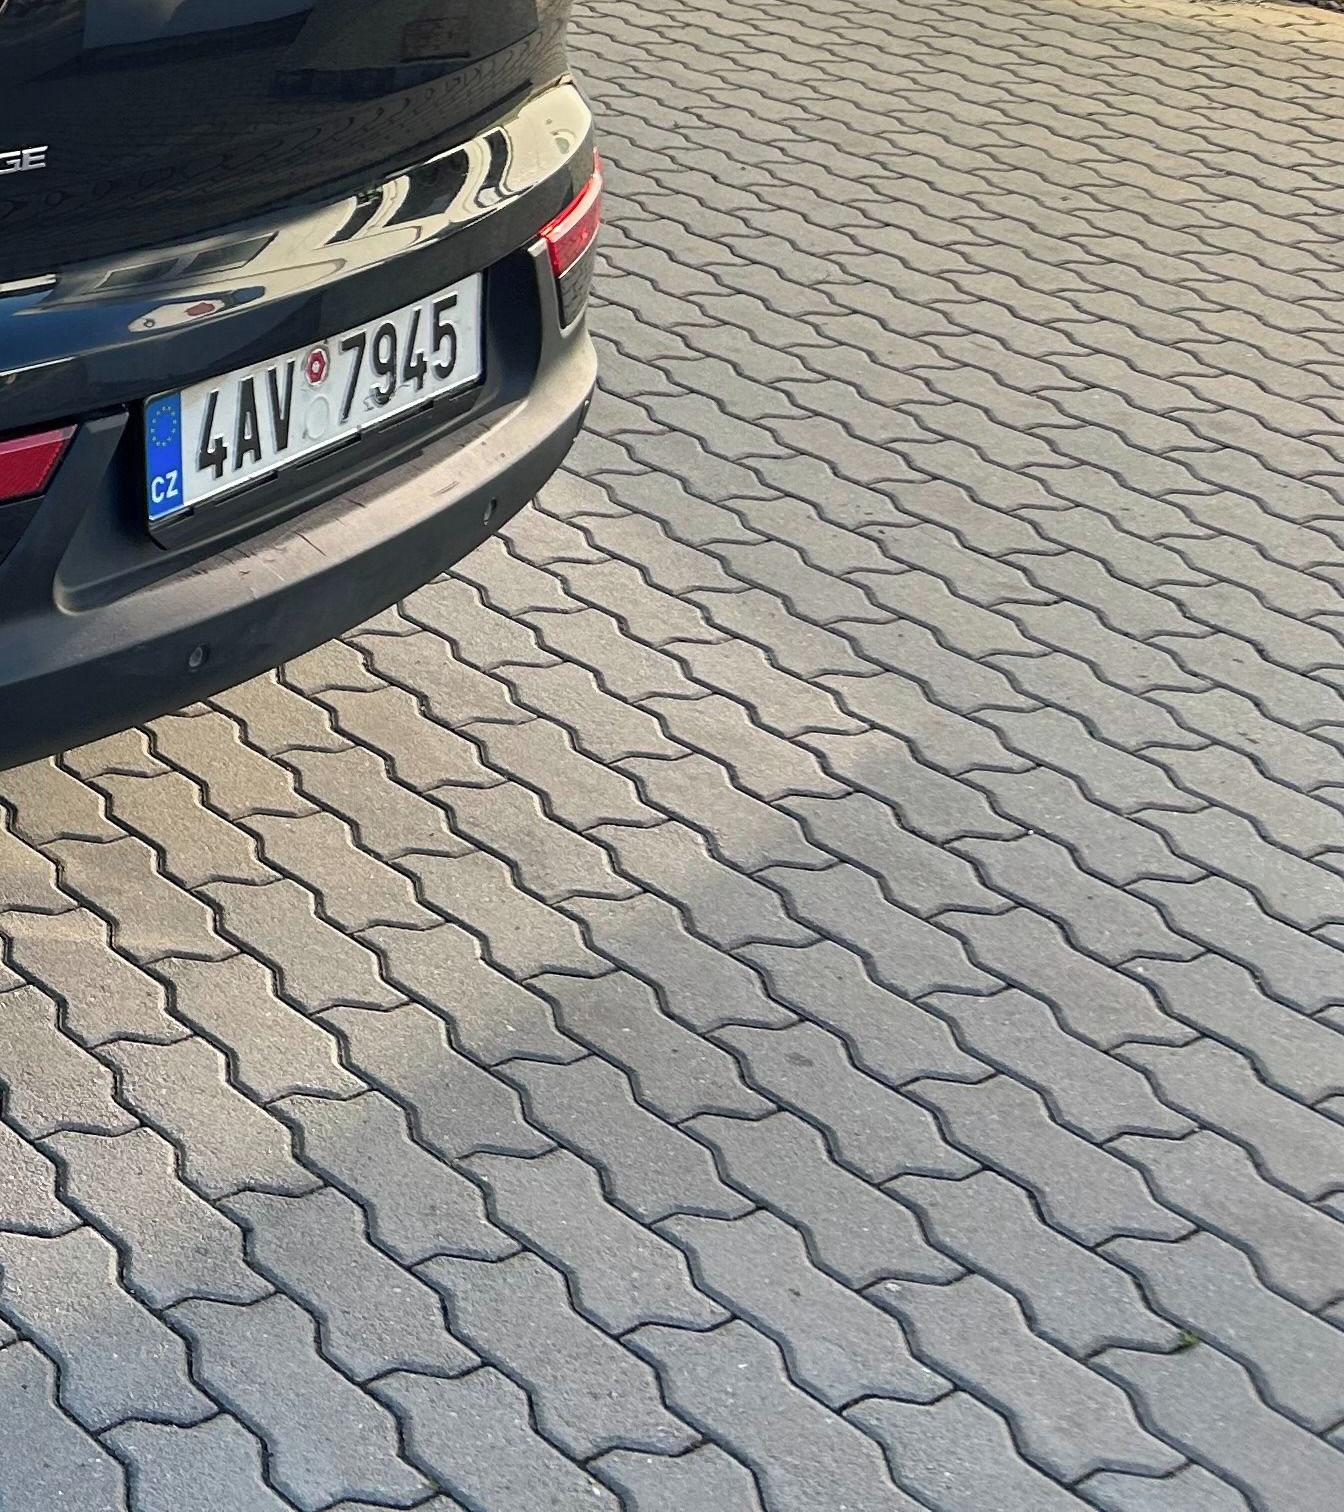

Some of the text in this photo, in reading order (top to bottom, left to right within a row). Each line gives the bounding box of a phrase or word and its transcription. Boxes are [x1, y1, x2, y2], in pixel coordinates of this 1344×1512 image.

[196, 292, 459, 480] 4AV 7945
[150, 469, 179, 505] CZ
